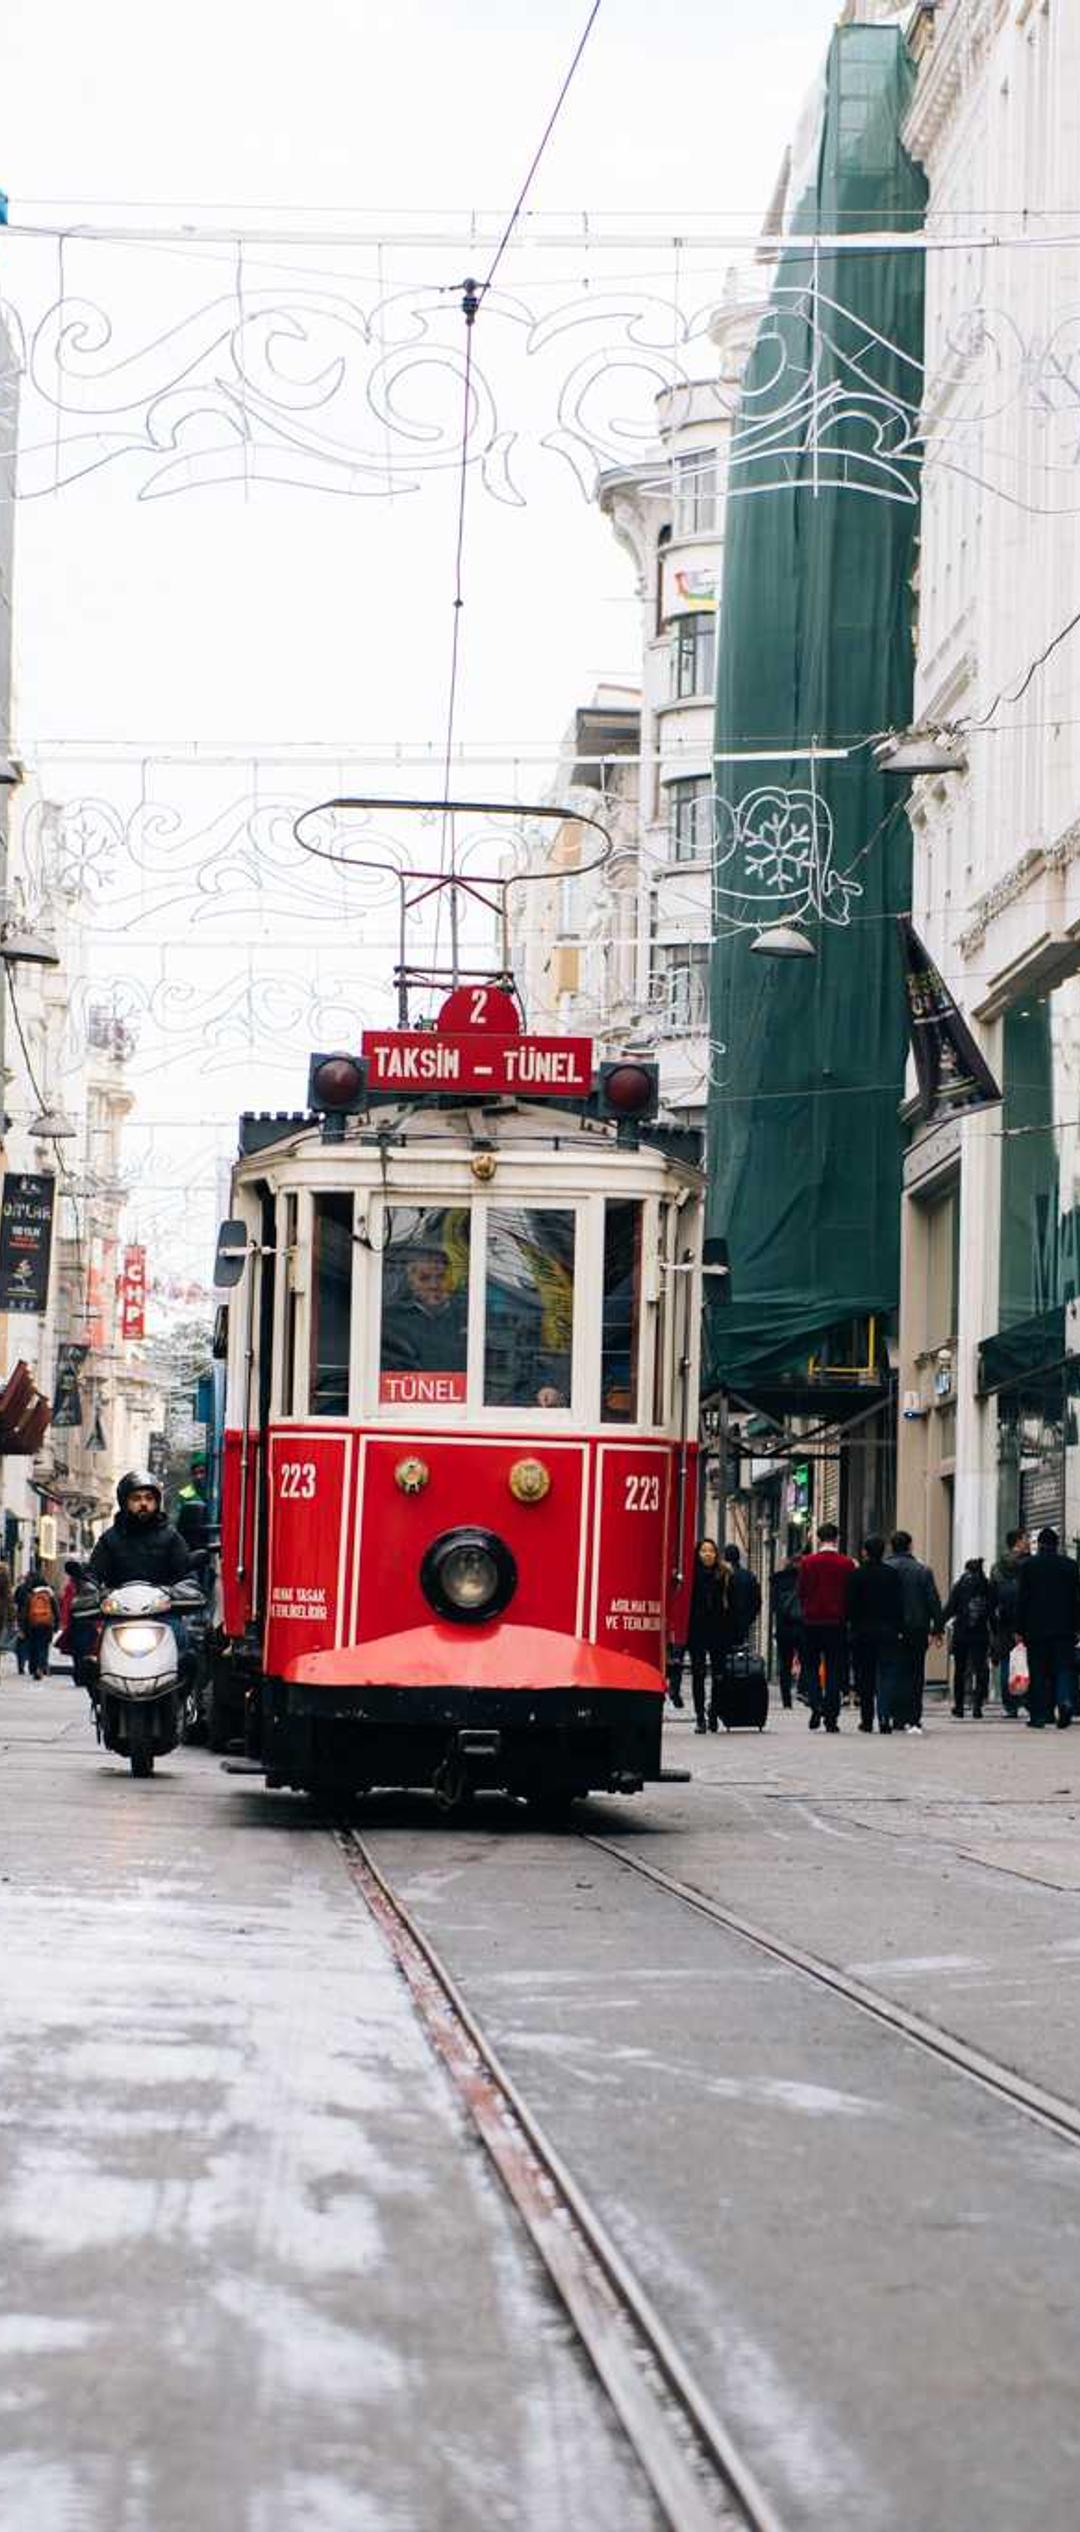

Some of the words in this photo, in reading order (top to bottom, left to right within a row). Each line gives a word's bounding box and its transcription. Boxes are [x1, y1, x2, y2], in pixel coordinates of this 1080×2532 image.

[469, 989, 488, 1024] 2
[374, 1042, 460, 1079] TAKSİM
[503, 1046, 584, 1084] TÜNEL
[126, 1264, 142, 1323] CHP
[386, 1375, 461, 1401] TÜNEL
[280, 1462, 316, 1498] 223
[625, 1475, 659, 1511] 223
[605, 1615, 620, 1630] VE
